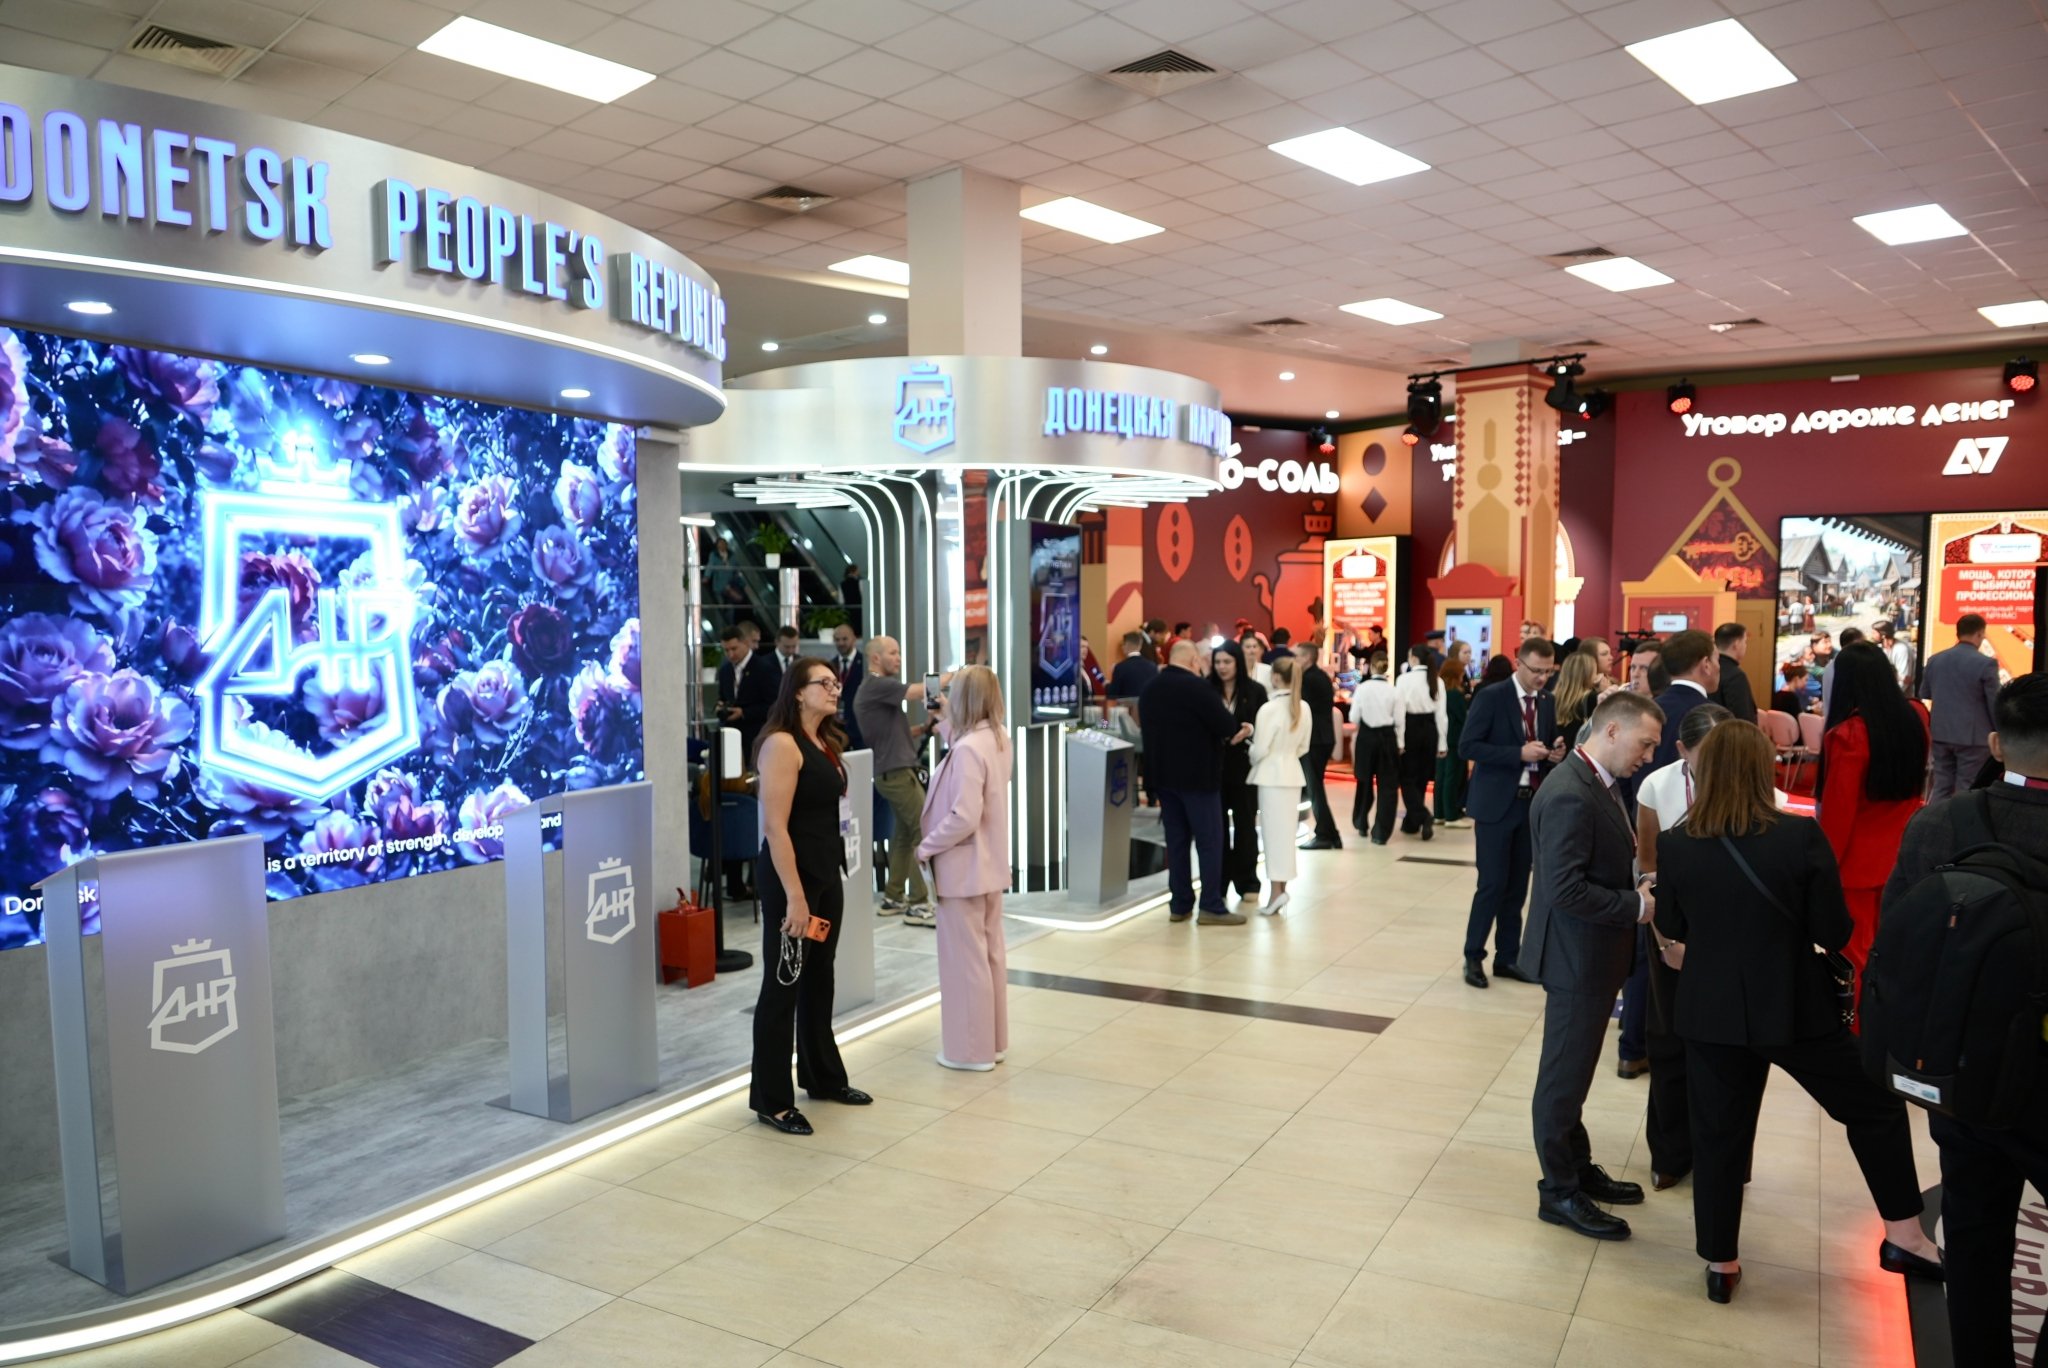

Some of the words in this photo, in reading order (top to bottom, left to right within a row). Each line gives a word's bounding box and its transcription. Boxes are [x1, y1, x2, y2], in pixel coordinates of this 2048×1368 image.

[0, 103, 333, 249] DONETSK
[382, 178, 605, 309] PEOPLE'S
[629, 251, 727, 362] REPUBLIC
[1044, 387, 1176, 439] ДОНЕЦКАЯ
[1681, 412, 1787, 437] Уговор
[1791, 404, 1916, 433] дороже
[1921, 399, 2014, 426] денег
[1956, 590, 2035, 602] ПРОФЕССИОНА
[1972, 579, 2033, 590] ВЫБИРАЮТ
[5, 885, 97, 916] Donsk
[267, 856, 282, 873] is
[284, 856, 296, 871] a
[299, 845, 365, 868] territory
[367, 839, 385, 856] of
[386, 831, 451, 853] strength,
[452, 823, 504, 843] develop
